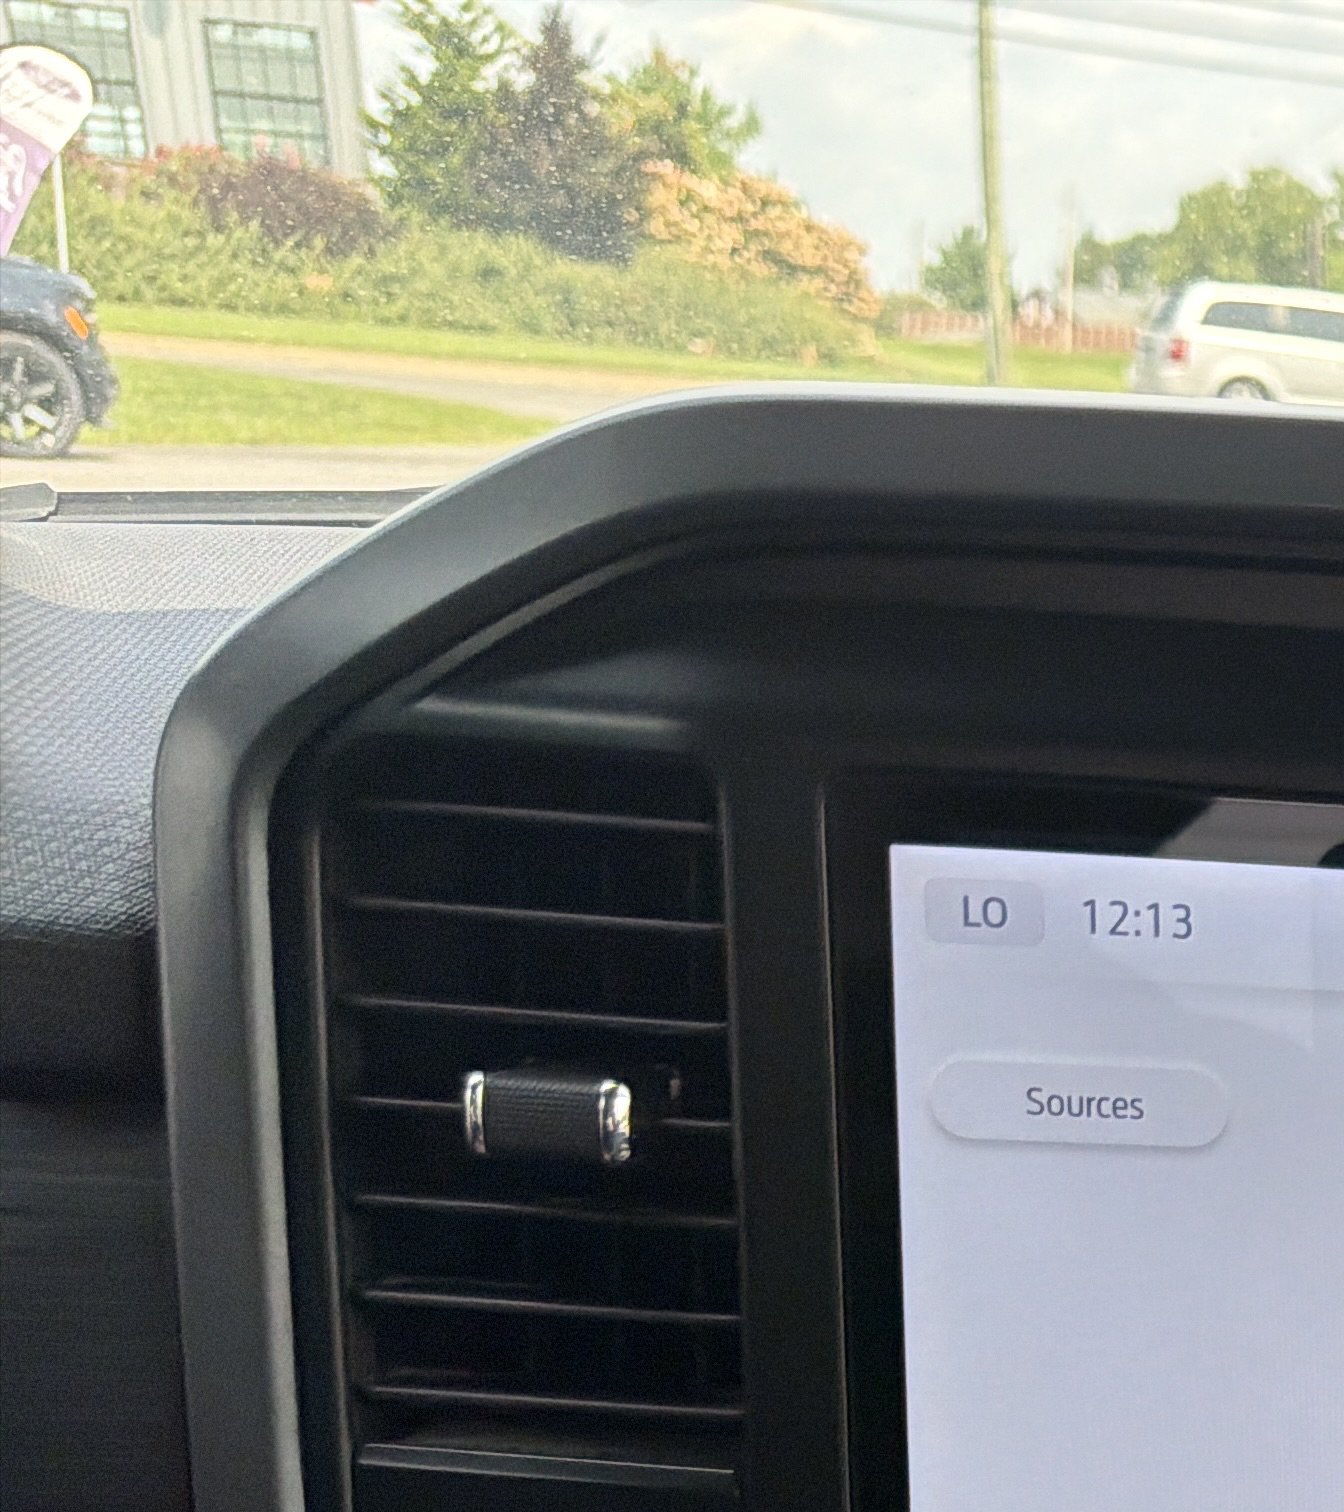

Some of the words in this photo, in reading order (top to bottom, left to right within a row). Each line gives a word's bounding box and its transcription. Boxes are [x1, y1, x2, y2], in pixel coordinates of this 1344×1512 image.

[961, 894, 1008, 929] LO
[1081, 899, 1194, 940] 12:13
[1025, 1086, 1145, 1121] Sources
